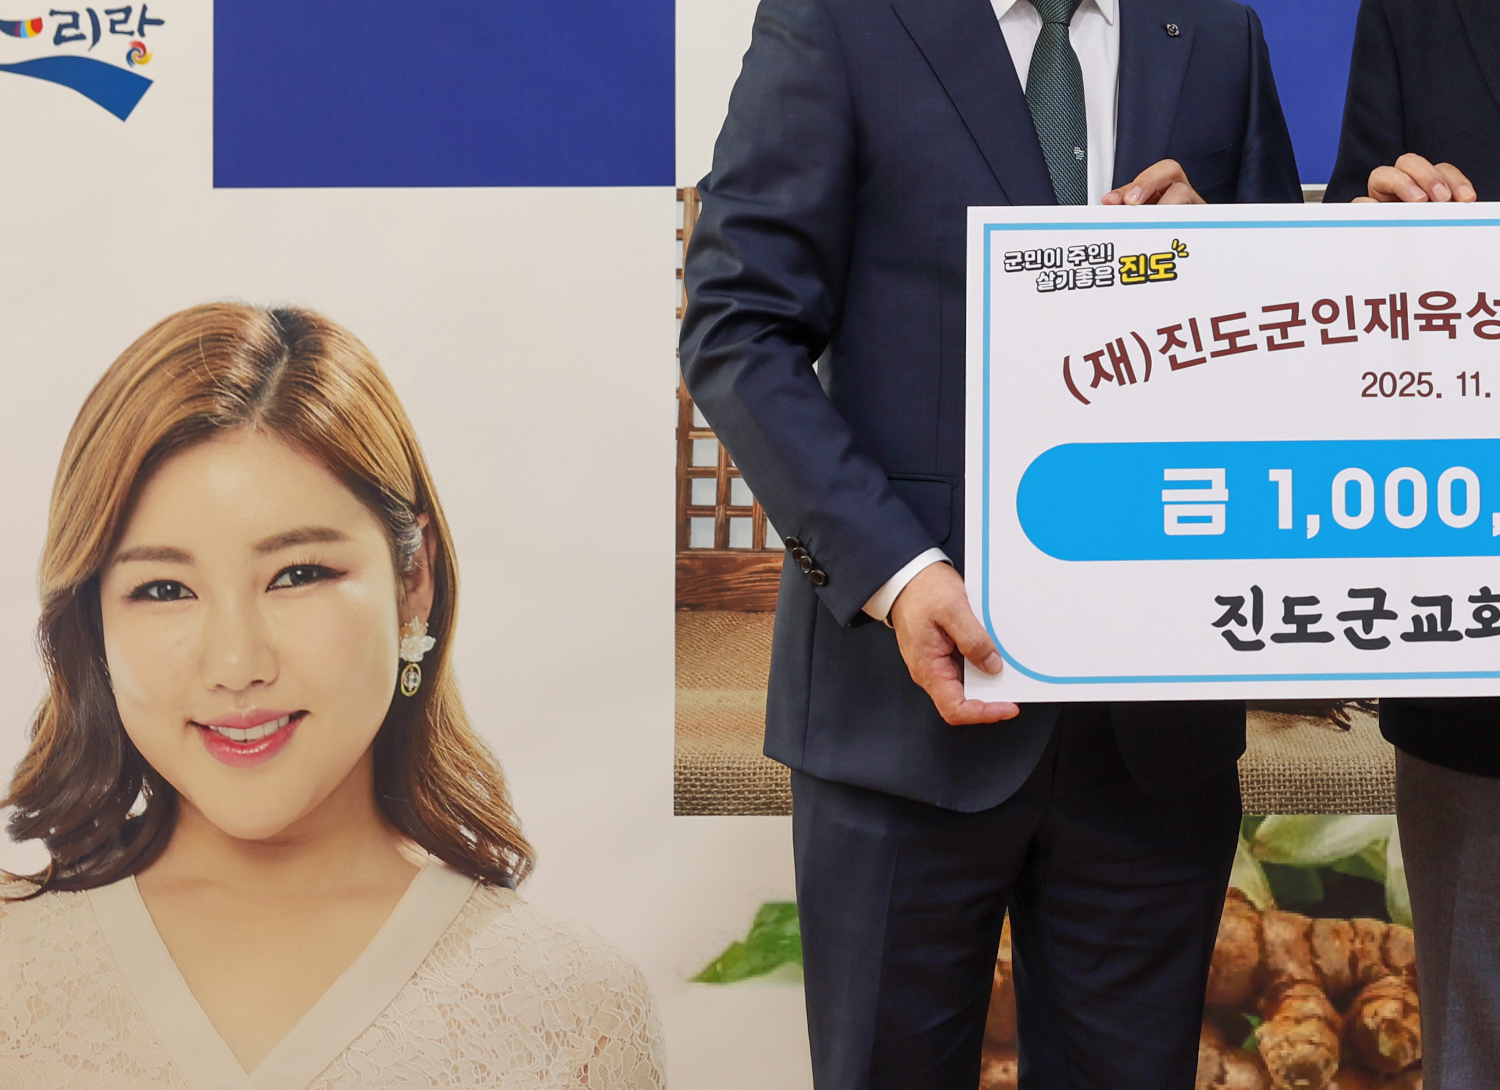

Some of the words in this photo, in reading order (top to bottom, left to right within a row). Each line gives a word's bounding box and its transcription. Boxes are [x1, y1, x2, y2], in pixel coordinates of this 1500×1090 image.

[0, 3, 166, 68] 리랑
[1003, 247, 1063, 272] 군민이
[1067, 242, 1115, 266] 주인!
[1036, 265, 1115, 293] 살기좋은
[1118, 251, 1178, 285] 진도
[1361, 371, 1442, 400] 2025.
[1456, 371, 1491, 399] 11.
[1161, 467, 1229, 536] 금
